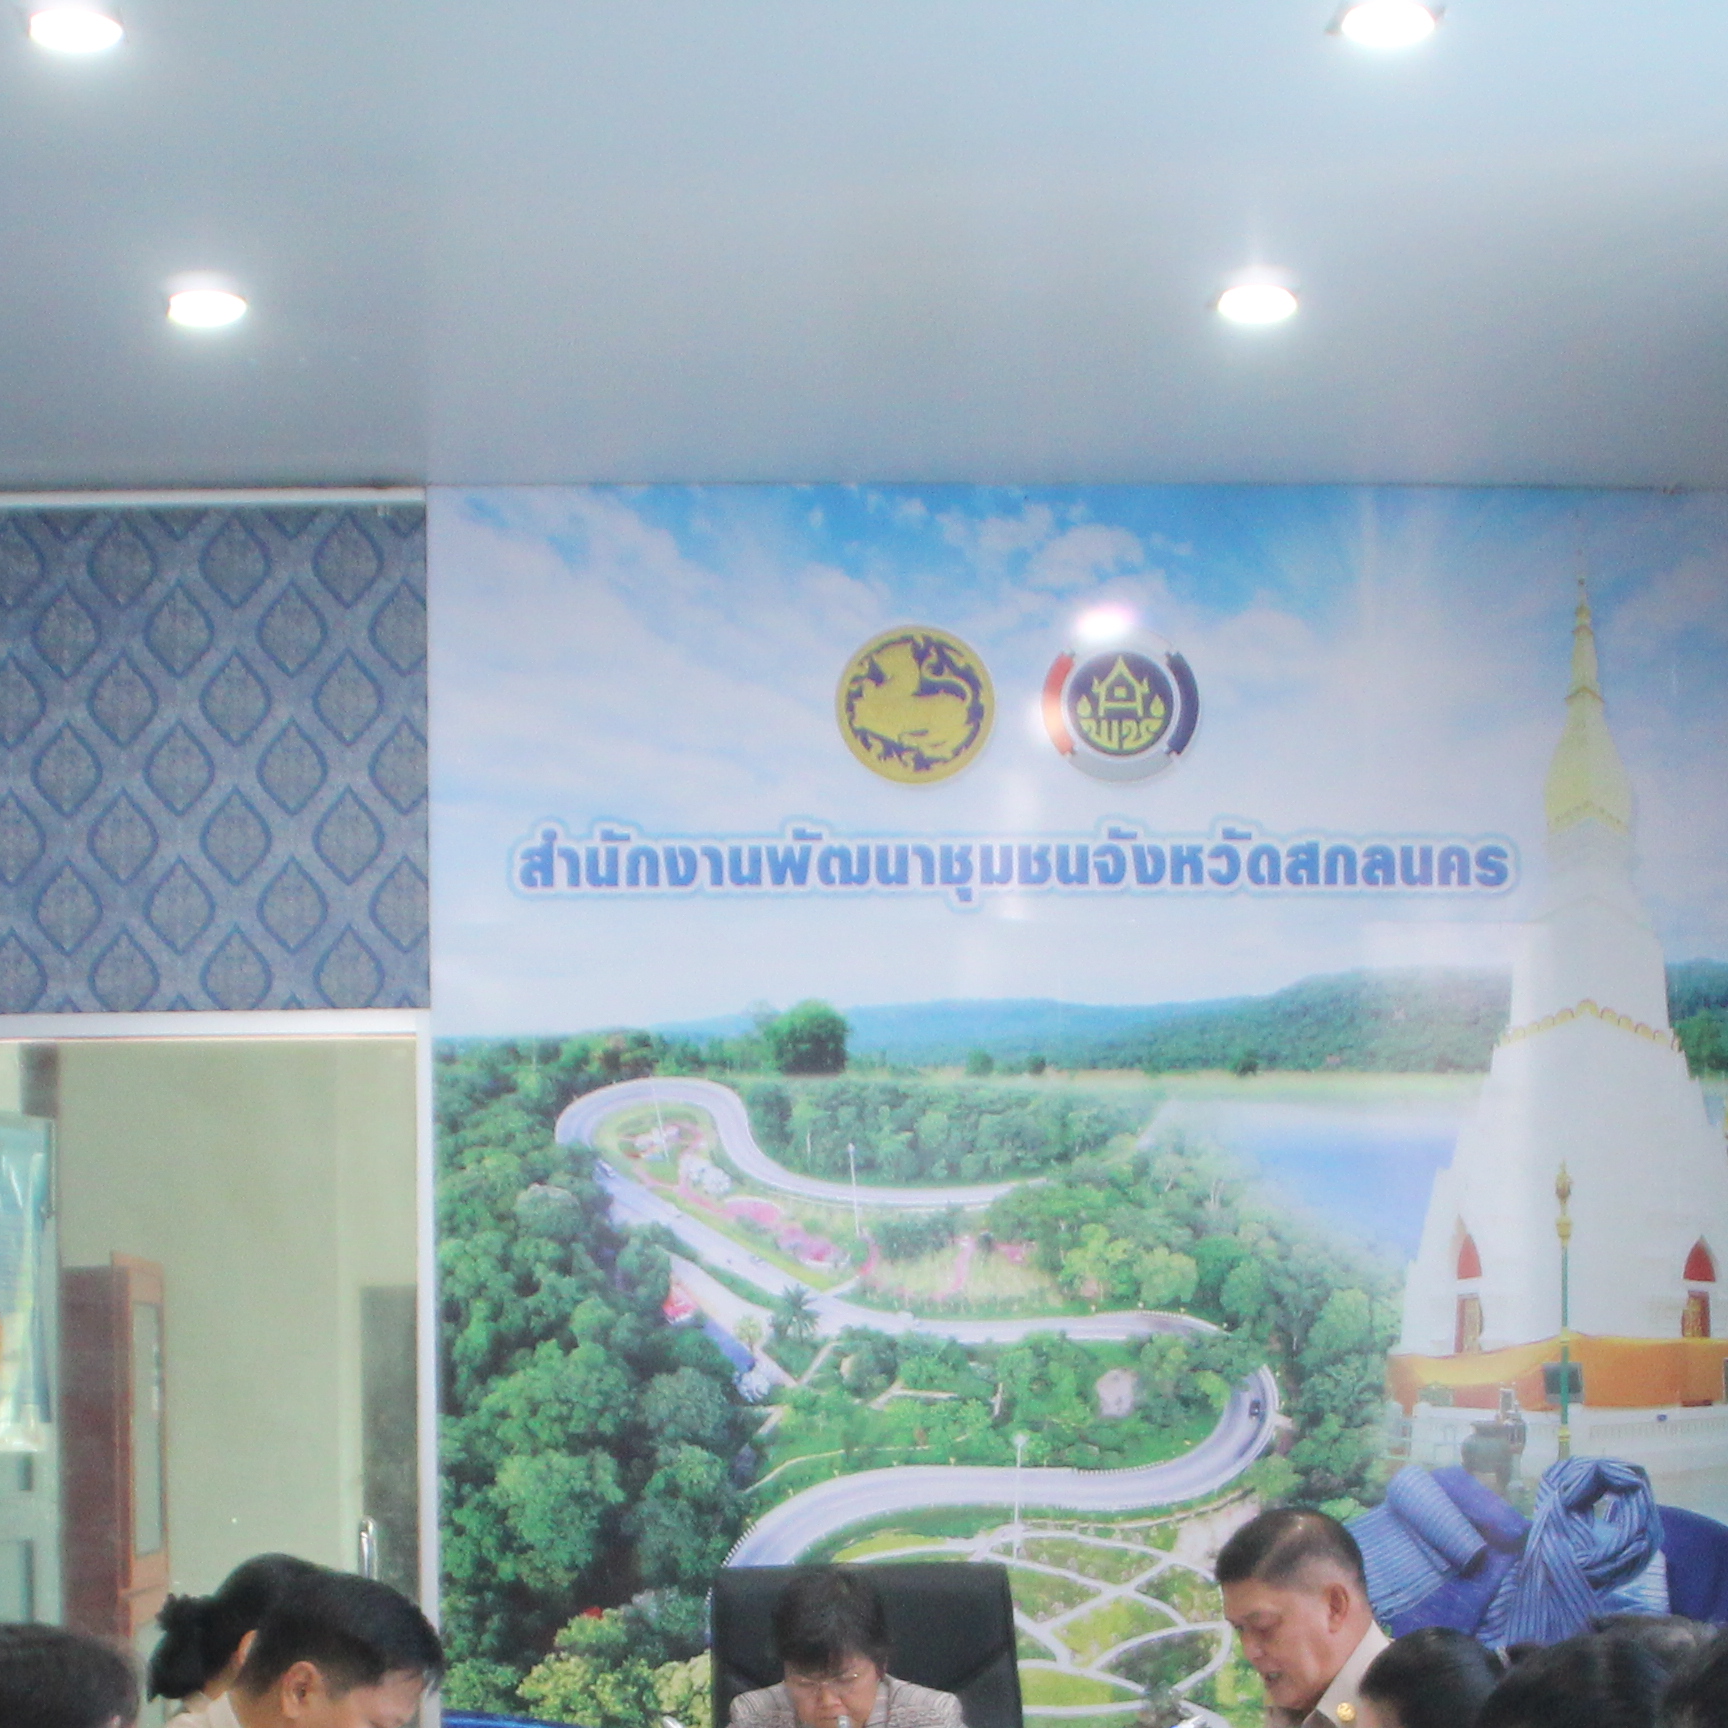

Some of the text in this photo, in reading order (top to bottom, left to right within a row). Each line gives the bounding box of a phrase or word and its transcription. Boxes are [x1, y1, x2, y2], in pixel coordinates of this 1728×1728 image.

[518, 827, 1510, 902] สำนักงานพัฒนาชุมชนจังหวัดสกลนคร
